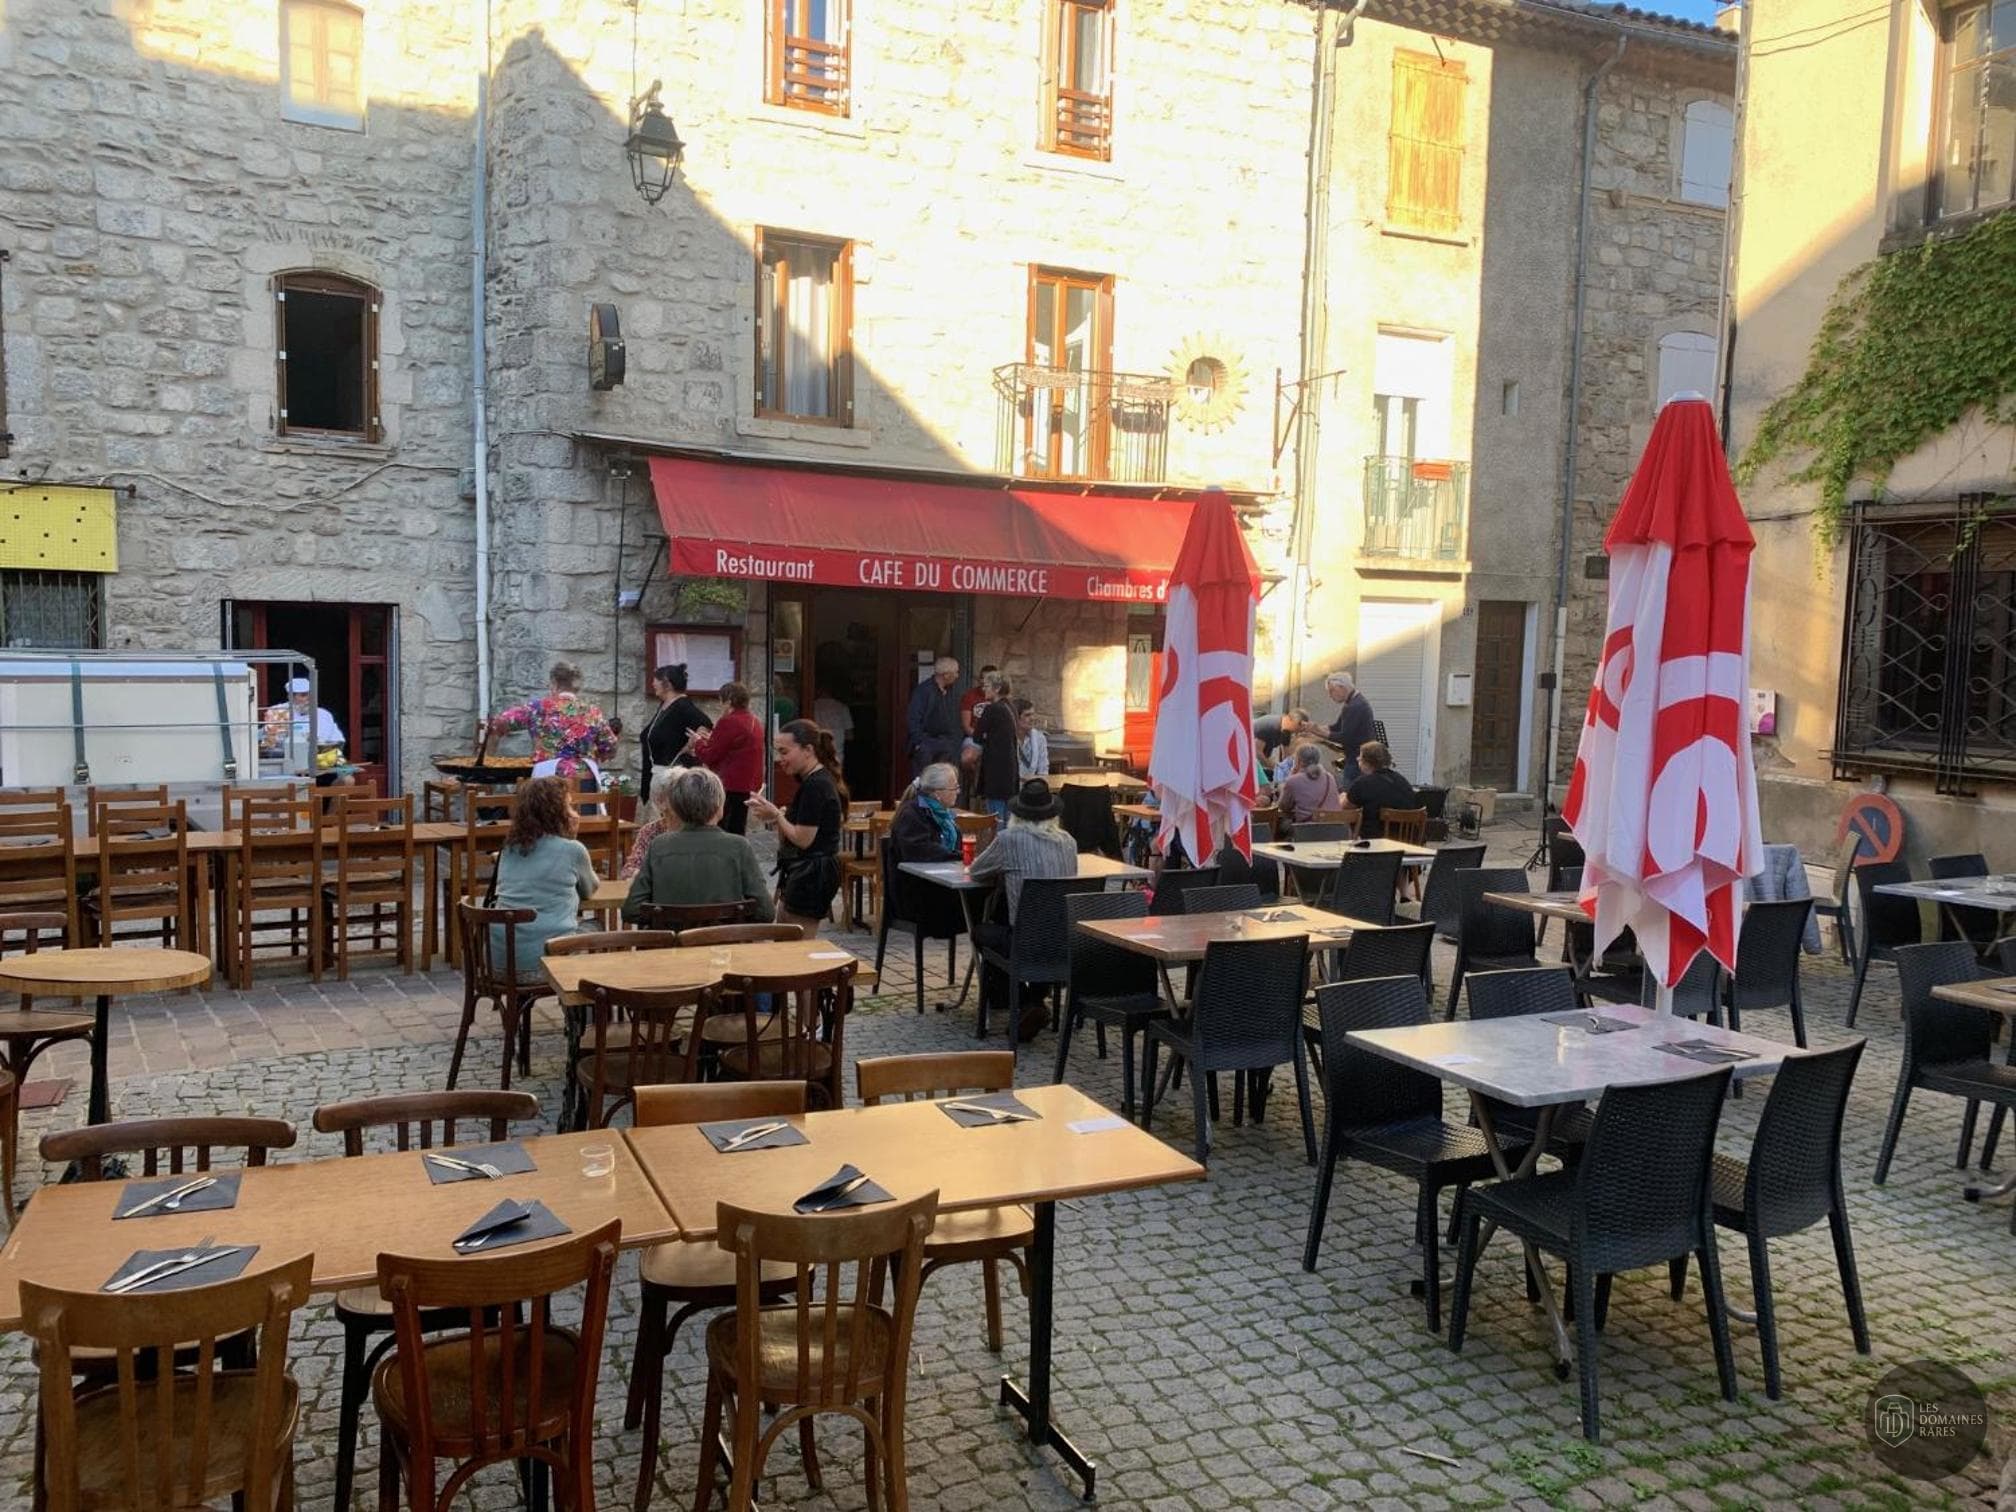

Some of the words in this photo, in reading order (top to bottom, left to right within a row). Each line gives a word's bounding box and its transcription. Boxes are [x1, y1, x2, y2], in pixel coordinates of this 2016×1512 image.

[716, 549, 815, 580] Restaurant
[859, 558, 903, 586] CAFE
[915, 562, 941, 587] DU
[952, 564, 1048, 594] COMMERCE
[1087, 575, 1153, 600] Chambres
